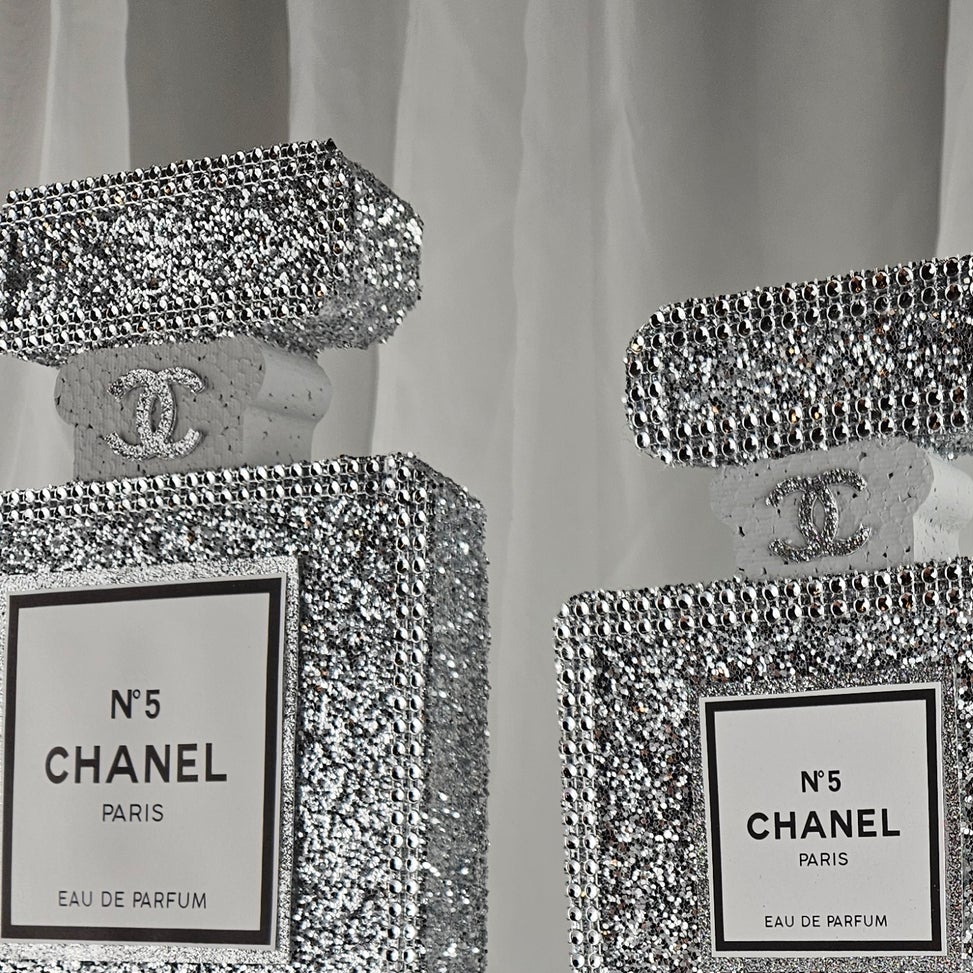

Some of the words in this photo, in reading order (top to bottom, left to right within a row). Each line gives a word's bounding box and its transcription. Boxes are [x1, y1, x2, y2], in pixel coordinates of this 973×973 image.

[45, 742, 228, 785] CHANEL
[102, 803, 164, 823] PARIS
[746, 808, 901, 841] CHANEL
[799, 851, 849, 867] PARIS
[58, 890, 93, 907] EAU
[101, 890, 125, 908] DE
[132, 891, 207, 909] PARFUM
[764, 915, 795, 928] EAU
[801, 915, 821, 928] DE
[826, 914, 888, 928] PARFUM
